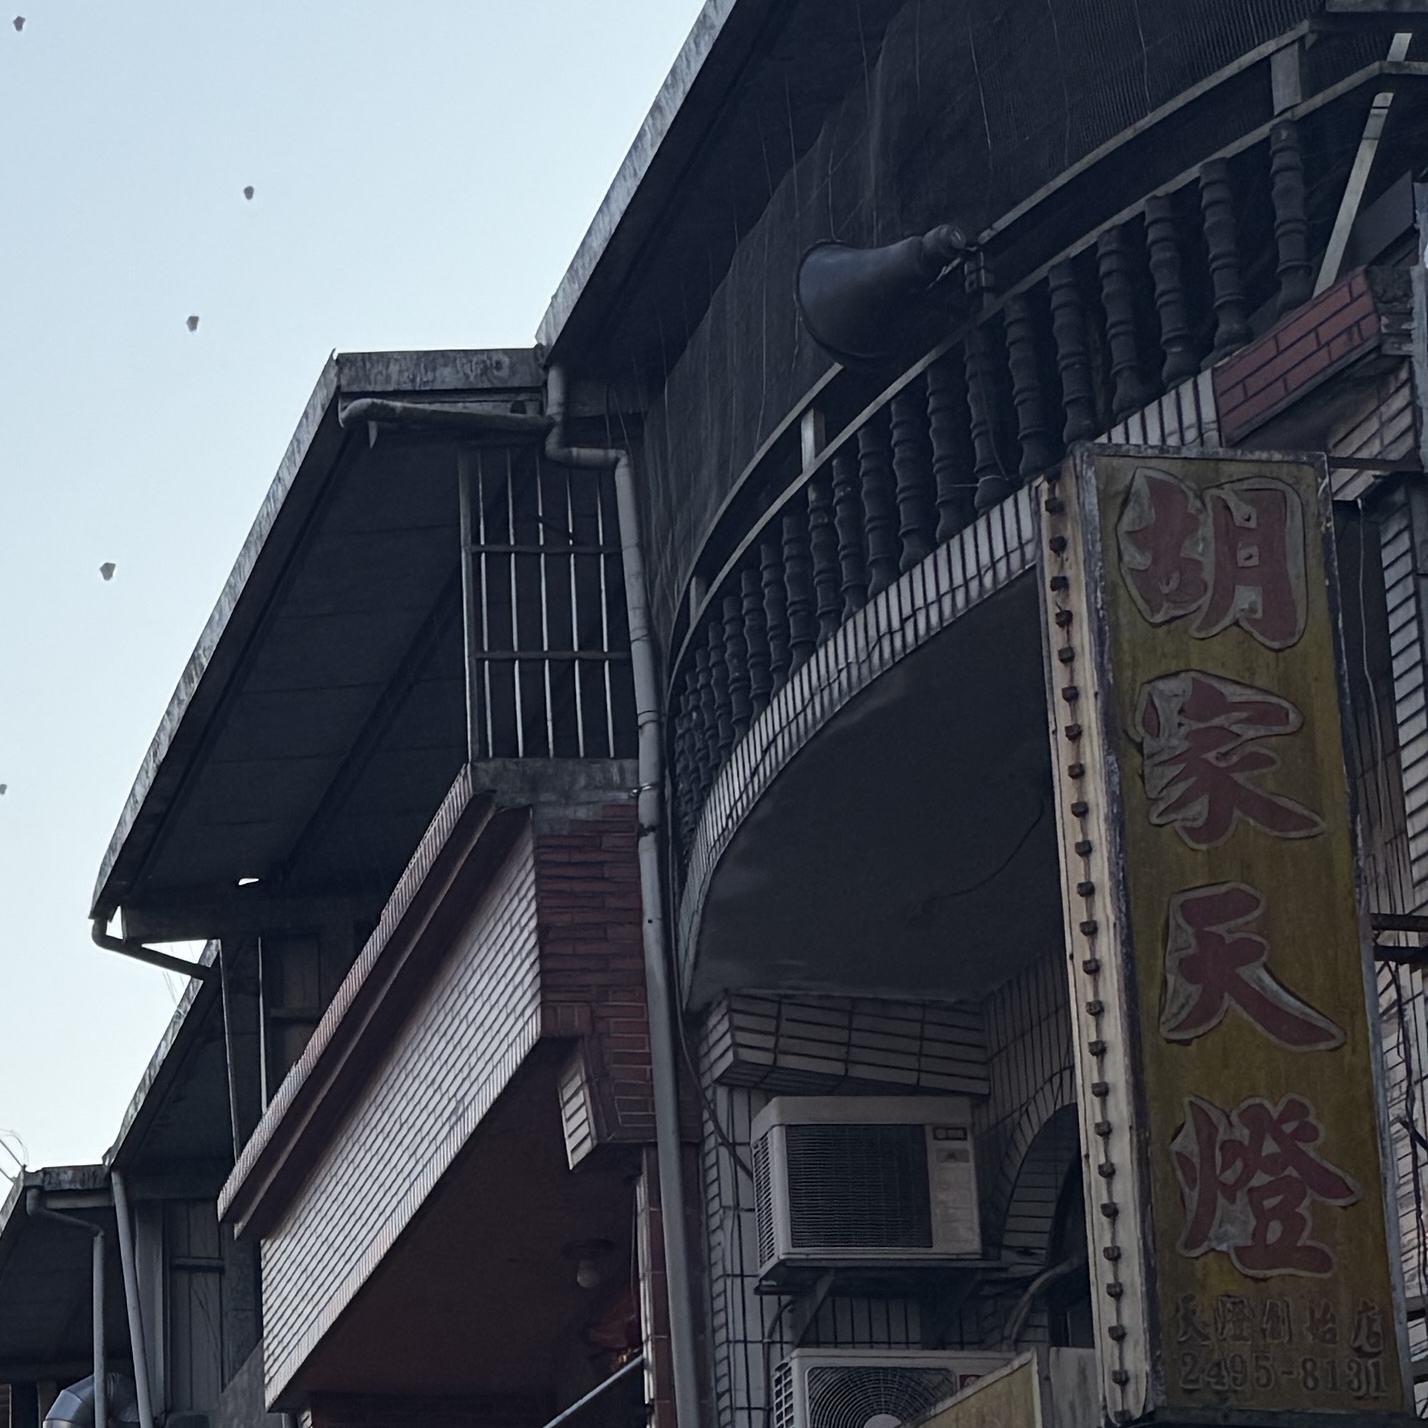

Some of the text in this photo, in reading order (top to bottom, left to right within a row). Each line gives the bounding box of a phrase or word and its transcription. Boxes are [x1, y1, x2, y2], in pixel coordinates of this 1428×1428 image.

[1118, 467, 1359, 1278] 胡家天燈
[1180, 1352, 1388, 1398] 2495-8131
